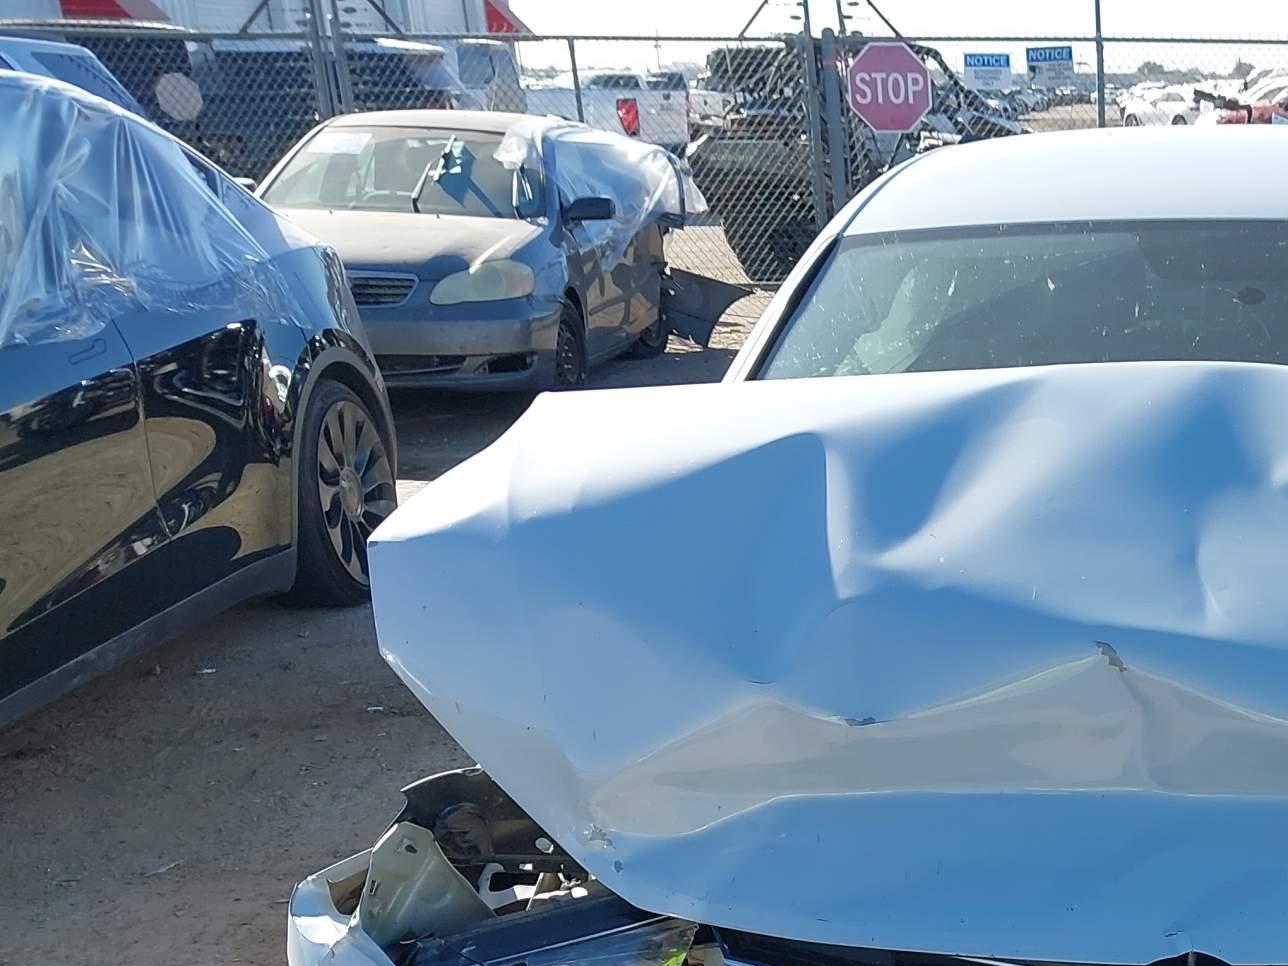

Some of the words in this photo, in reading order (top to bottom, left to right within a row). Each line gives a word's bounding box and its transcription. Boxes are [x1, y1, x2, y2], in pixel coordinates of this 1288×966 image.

[1028, 48, 1070, 60] NOTICE
[966, 55, 1008, 66] NOTICE
[854, 72, 924, 105] STOP
